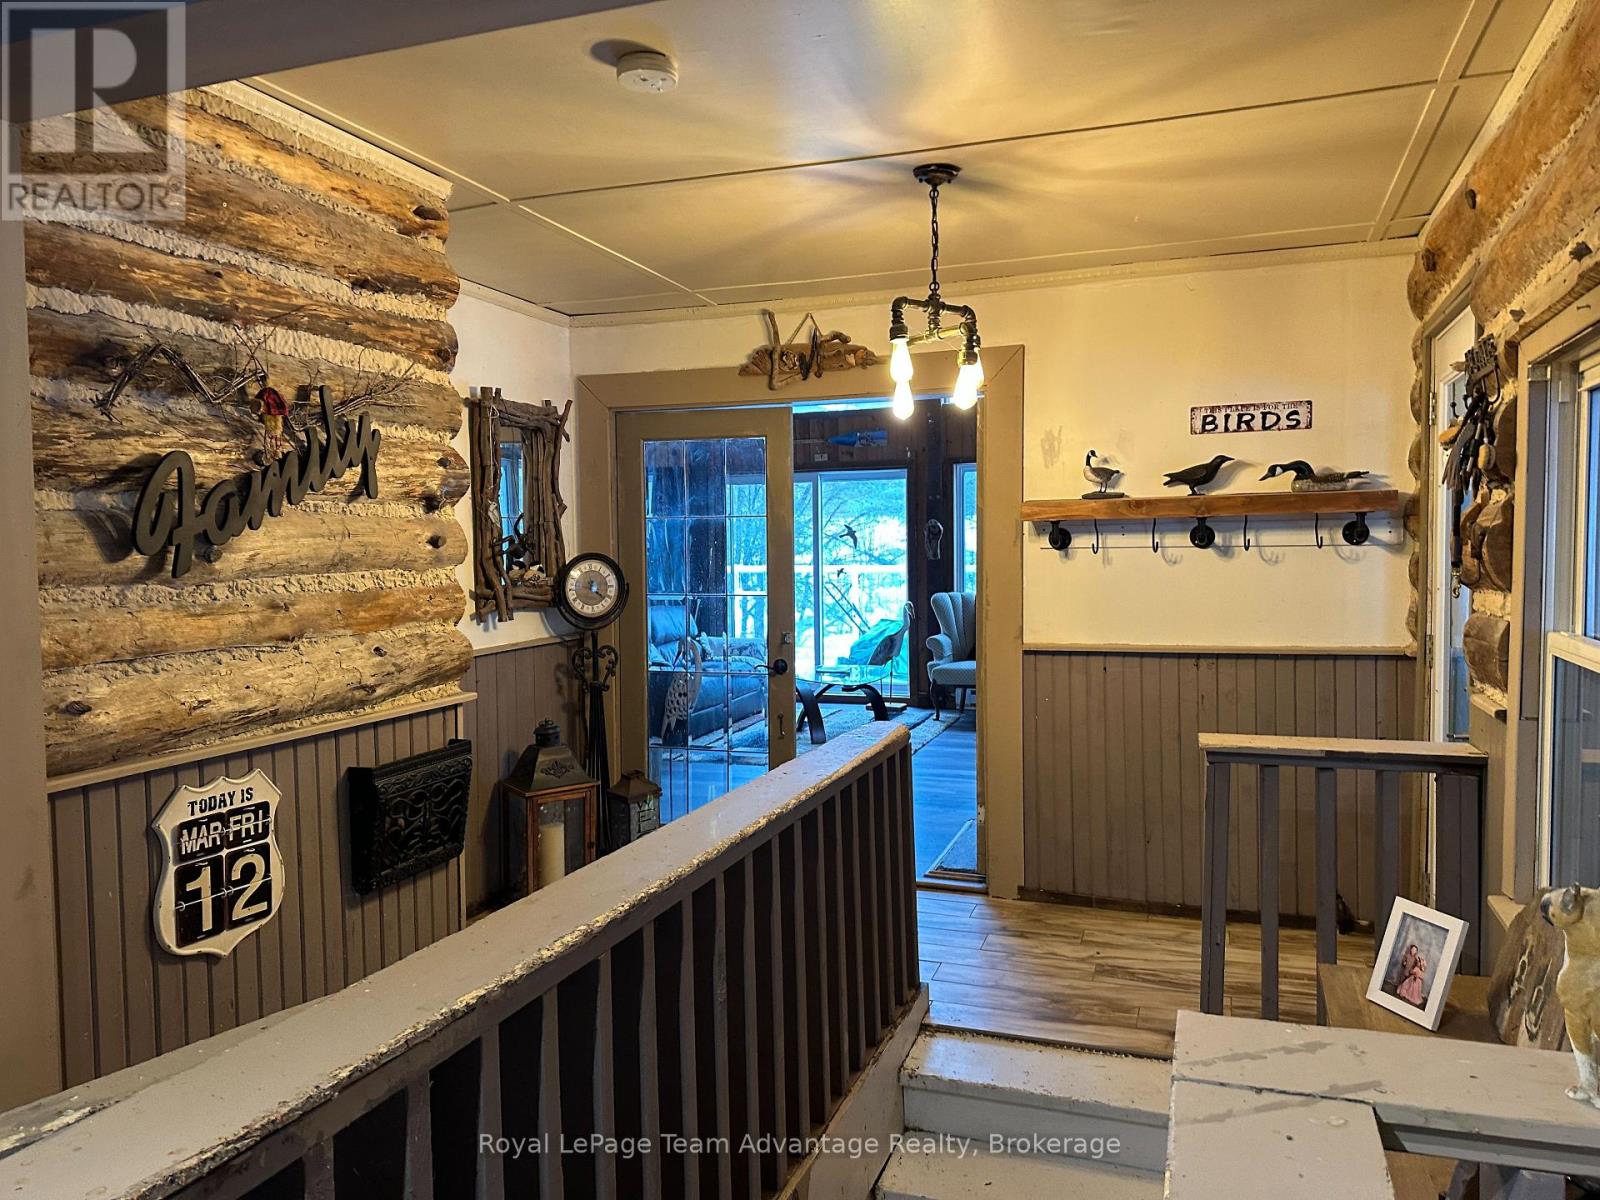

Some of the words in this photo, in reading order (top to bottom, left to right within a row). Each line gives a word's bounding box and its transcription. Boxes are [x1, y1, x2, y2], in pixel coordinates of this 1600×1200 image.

[1201, 410, 1301, 432] BIRDS
[132, 385, 381, 578] Family
[188, 791, 236, 816] TODAY
[240, 787, 254, 804] IS
[180, 821, 221, 855] MAR
[229, 809, 264, 841] FRI
[186, 854, 268, 932] 12
